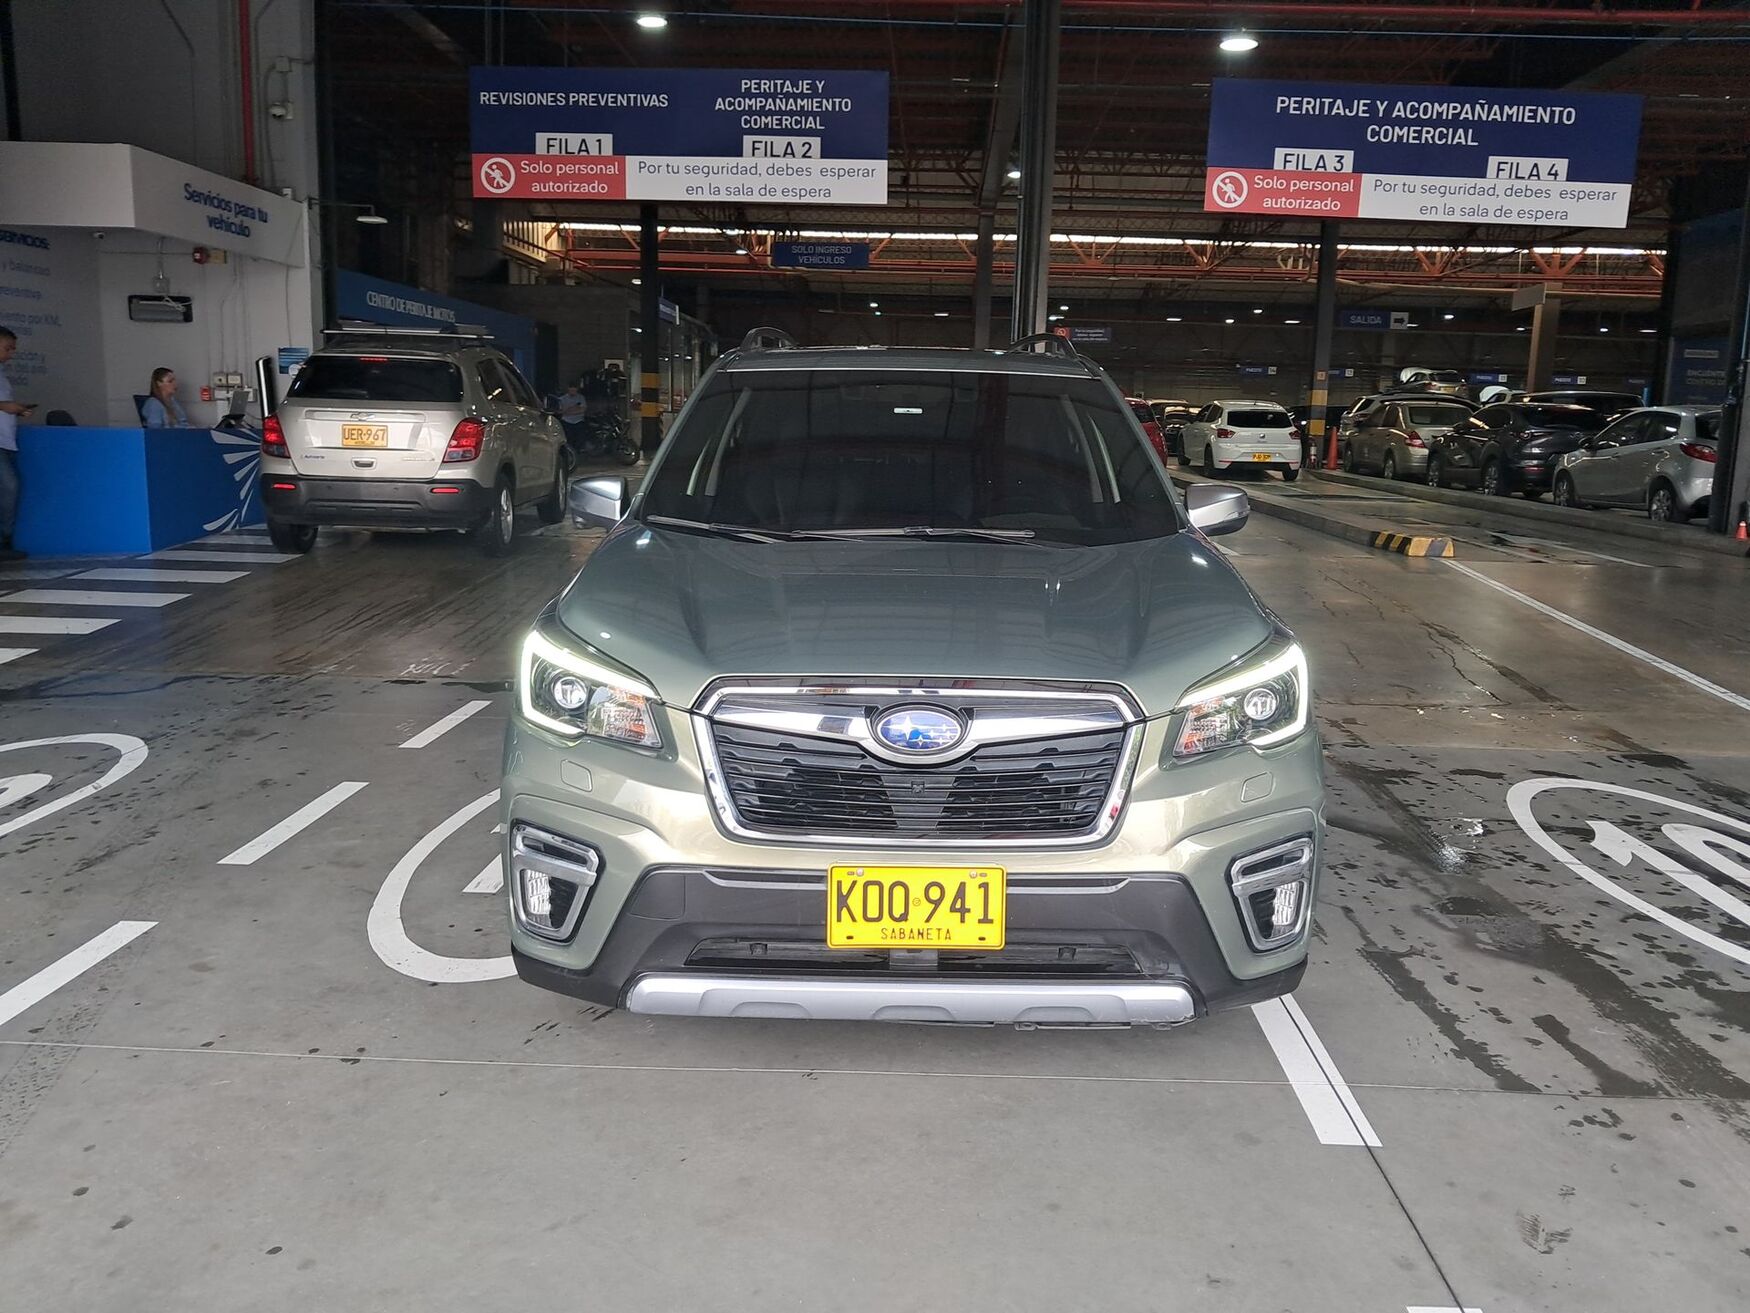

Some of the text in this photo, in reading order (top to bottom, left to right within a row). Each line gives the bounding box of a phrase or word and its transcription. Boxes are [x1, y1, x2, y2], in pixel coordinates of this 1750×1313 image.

[741, 79, 825, 94] PERITAJE Y
[480, 92, 668, 107] REVISIONES PREVENTIVAS
[715, 95, 851, 112] ACOMPAÑAMIENTO
[1276, 96, 1576, 125] PERITAJE Y ACOMPAÑAMIENTO
[741, 115, 825, 129] COMERCIAL
[1367, 125, 1479, 146] COMERCIAL
[546, 138, 602, 155] FILA 1
[752, 140, 812, 158] FILA 2
[521, 160, 619, 178] Solo personal
[638, 161, 877, 180] Por tu seguridad, debes esperar
[1283, 153, 1344, 172] FILA 3
[1496, 162, 1559, 180] FILA 4
[531, 180, 608, 193] autorizado
[686, 182, 832, 201] en la sala de espera
[1254, 174, 1354, 196] Solo personal
[1373, 179, 1617, 203] Por tu seguridad, debes esperar
[184, 182, 268, 223] Servicios para tu
[1263, 196, 1341, 211] autorizado
[1420, 203, 1569, 222] en la sala de espera
[791, 245, 852, 255] SOLO INGRESO
[1349, 315, 1382, 324] SALIDA
[881, 927, 952, 941] SABANETA
